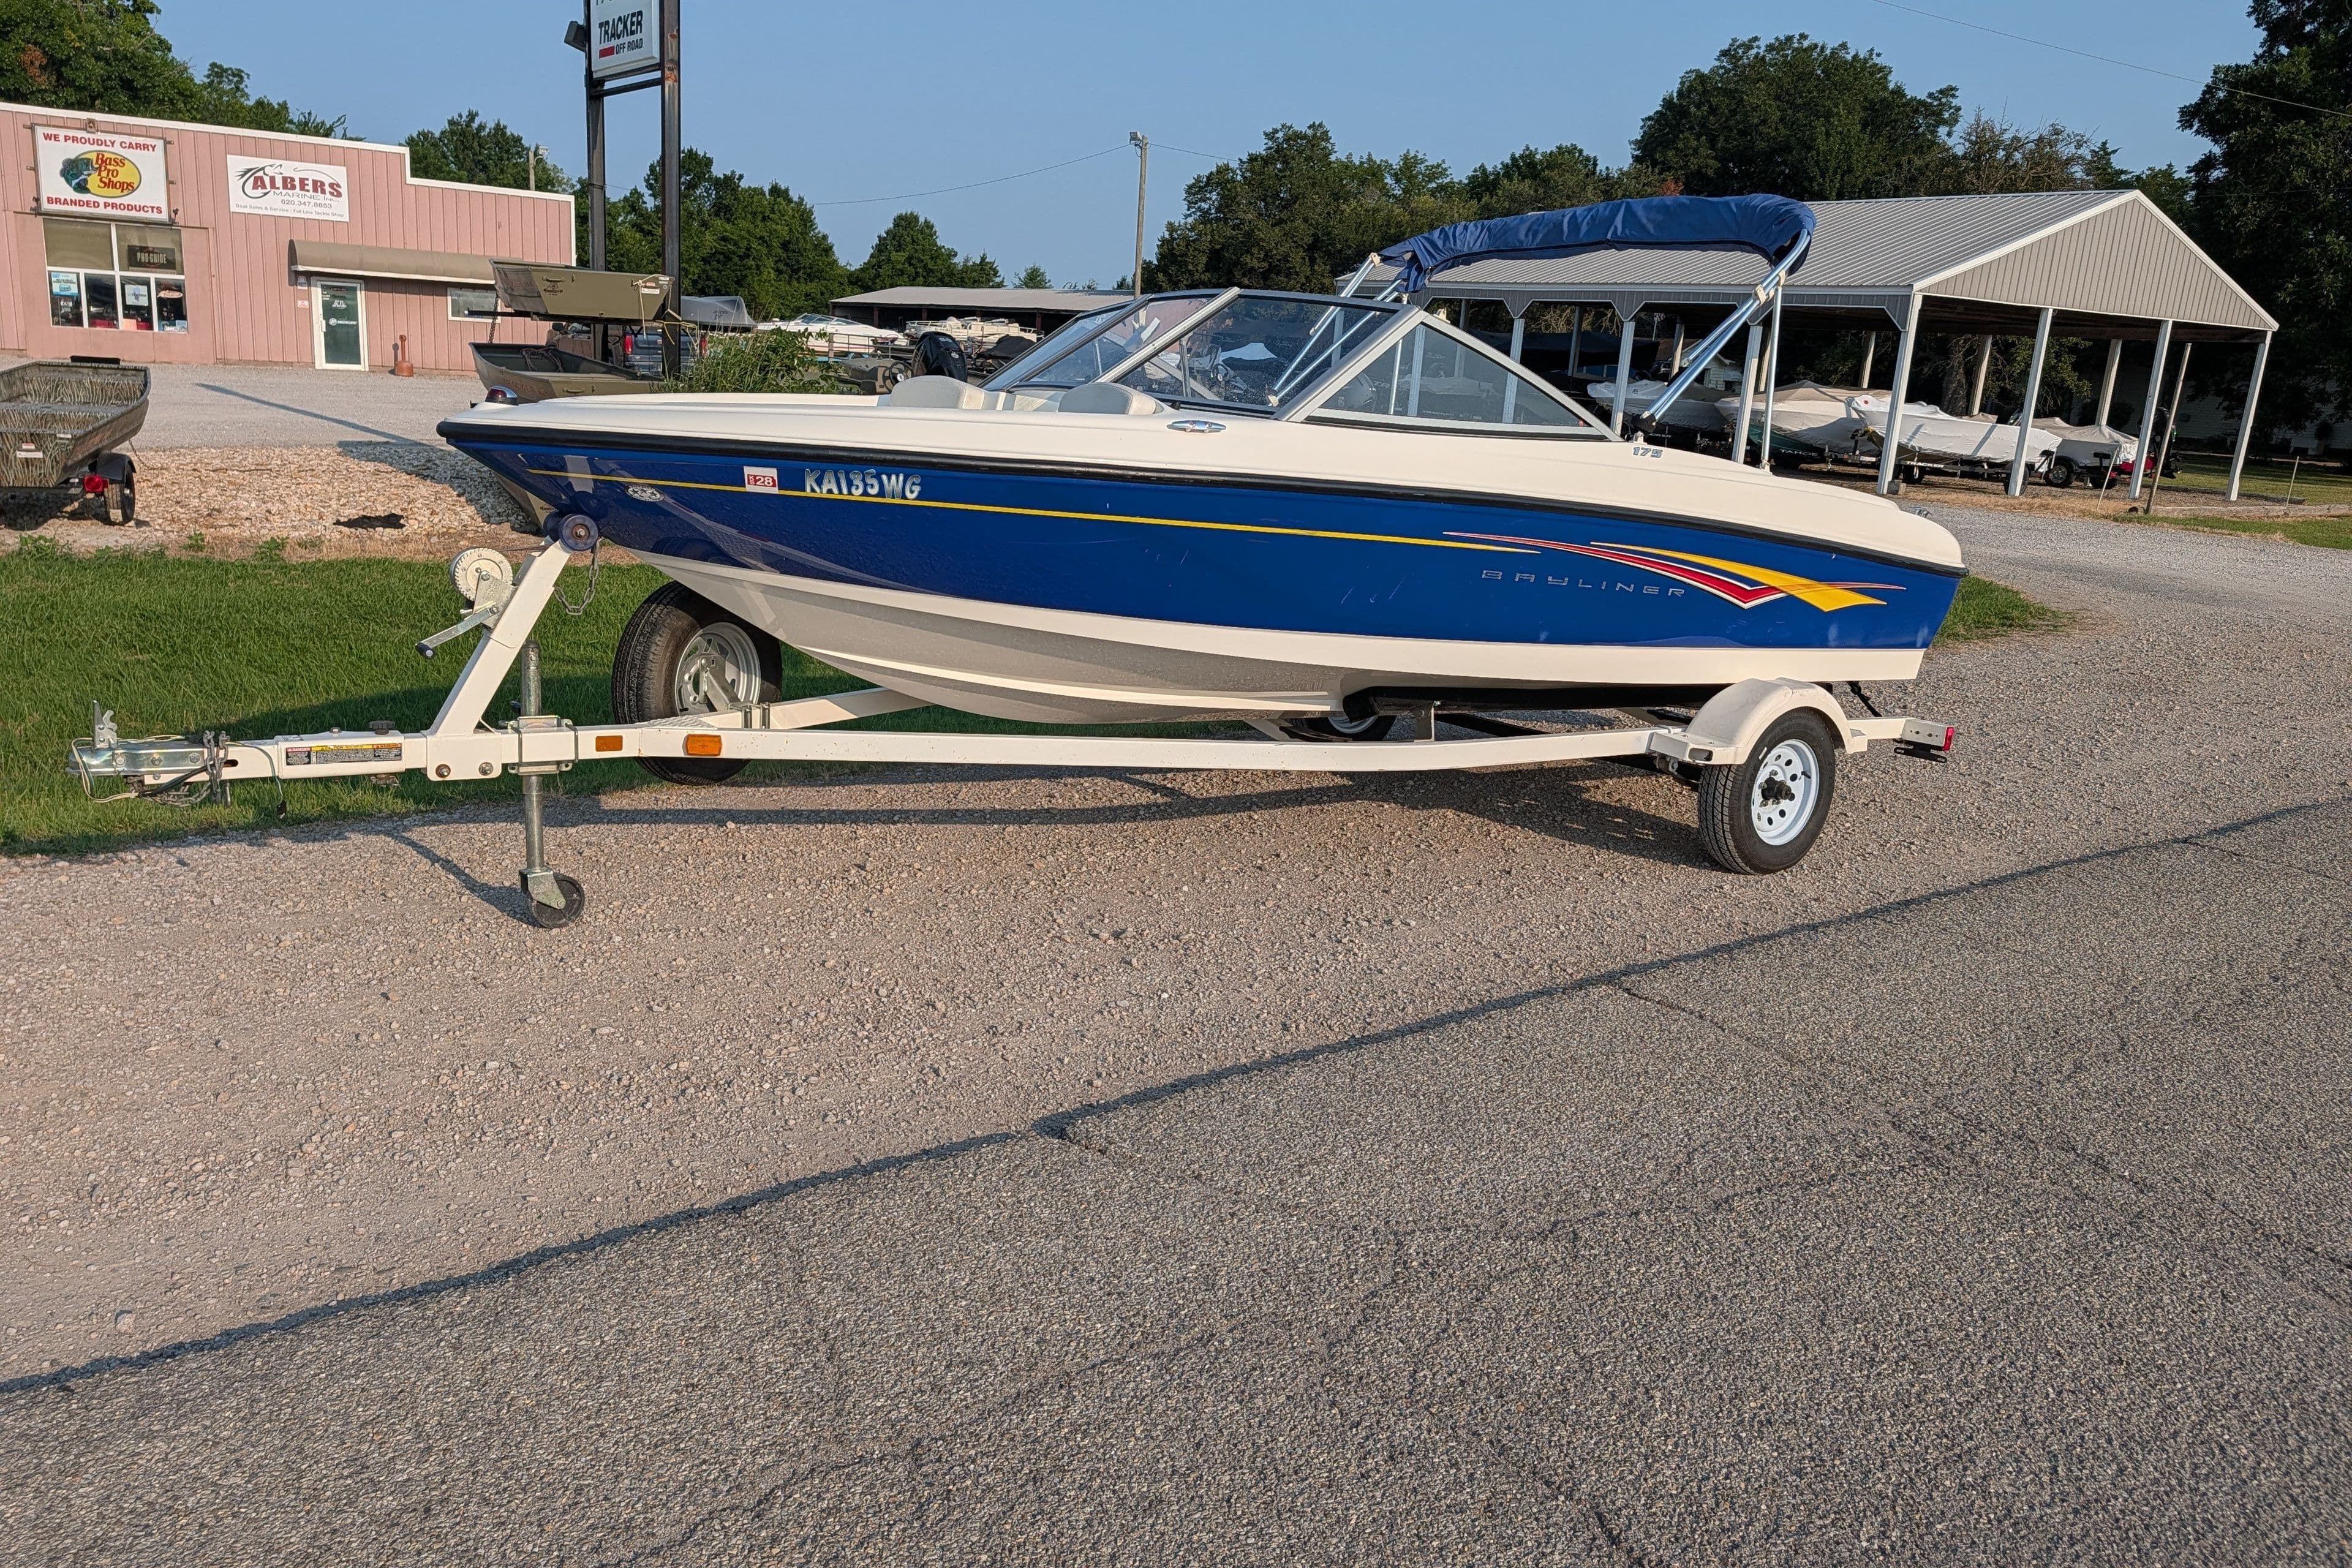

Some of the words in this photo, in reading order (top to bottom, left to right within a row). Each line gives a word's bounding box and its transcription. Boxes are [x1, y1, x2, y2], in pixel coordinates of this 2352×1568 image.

[598, 10, 643, 45] TRACKER
[616, 42, 626, 55] OFF
[627, 38, 643, 52] ROAD
[43, 132, 60, 141] WE
[64, 135, 116, 148] PROUDLY
[119, 141, 157, 152] CARRY
[95, 153, 126, 167] Bass
[97, 165, 119, 178] Pro
[98, 176, 135, 192] Shops
[252, 176, 342, 198] ALBERS
[273, 190, 320, 200] MARINE
[47, 197, 100, 208] BRANDED
[104, 202, 162, 214] PRODUCTS
[281, 199, 333, 209] 620.347.8853
[1633, 447, 1663, 458] 175
[756, 476, 773, 486] 28
[1482, 570, 1685, 597] BAYLINER
